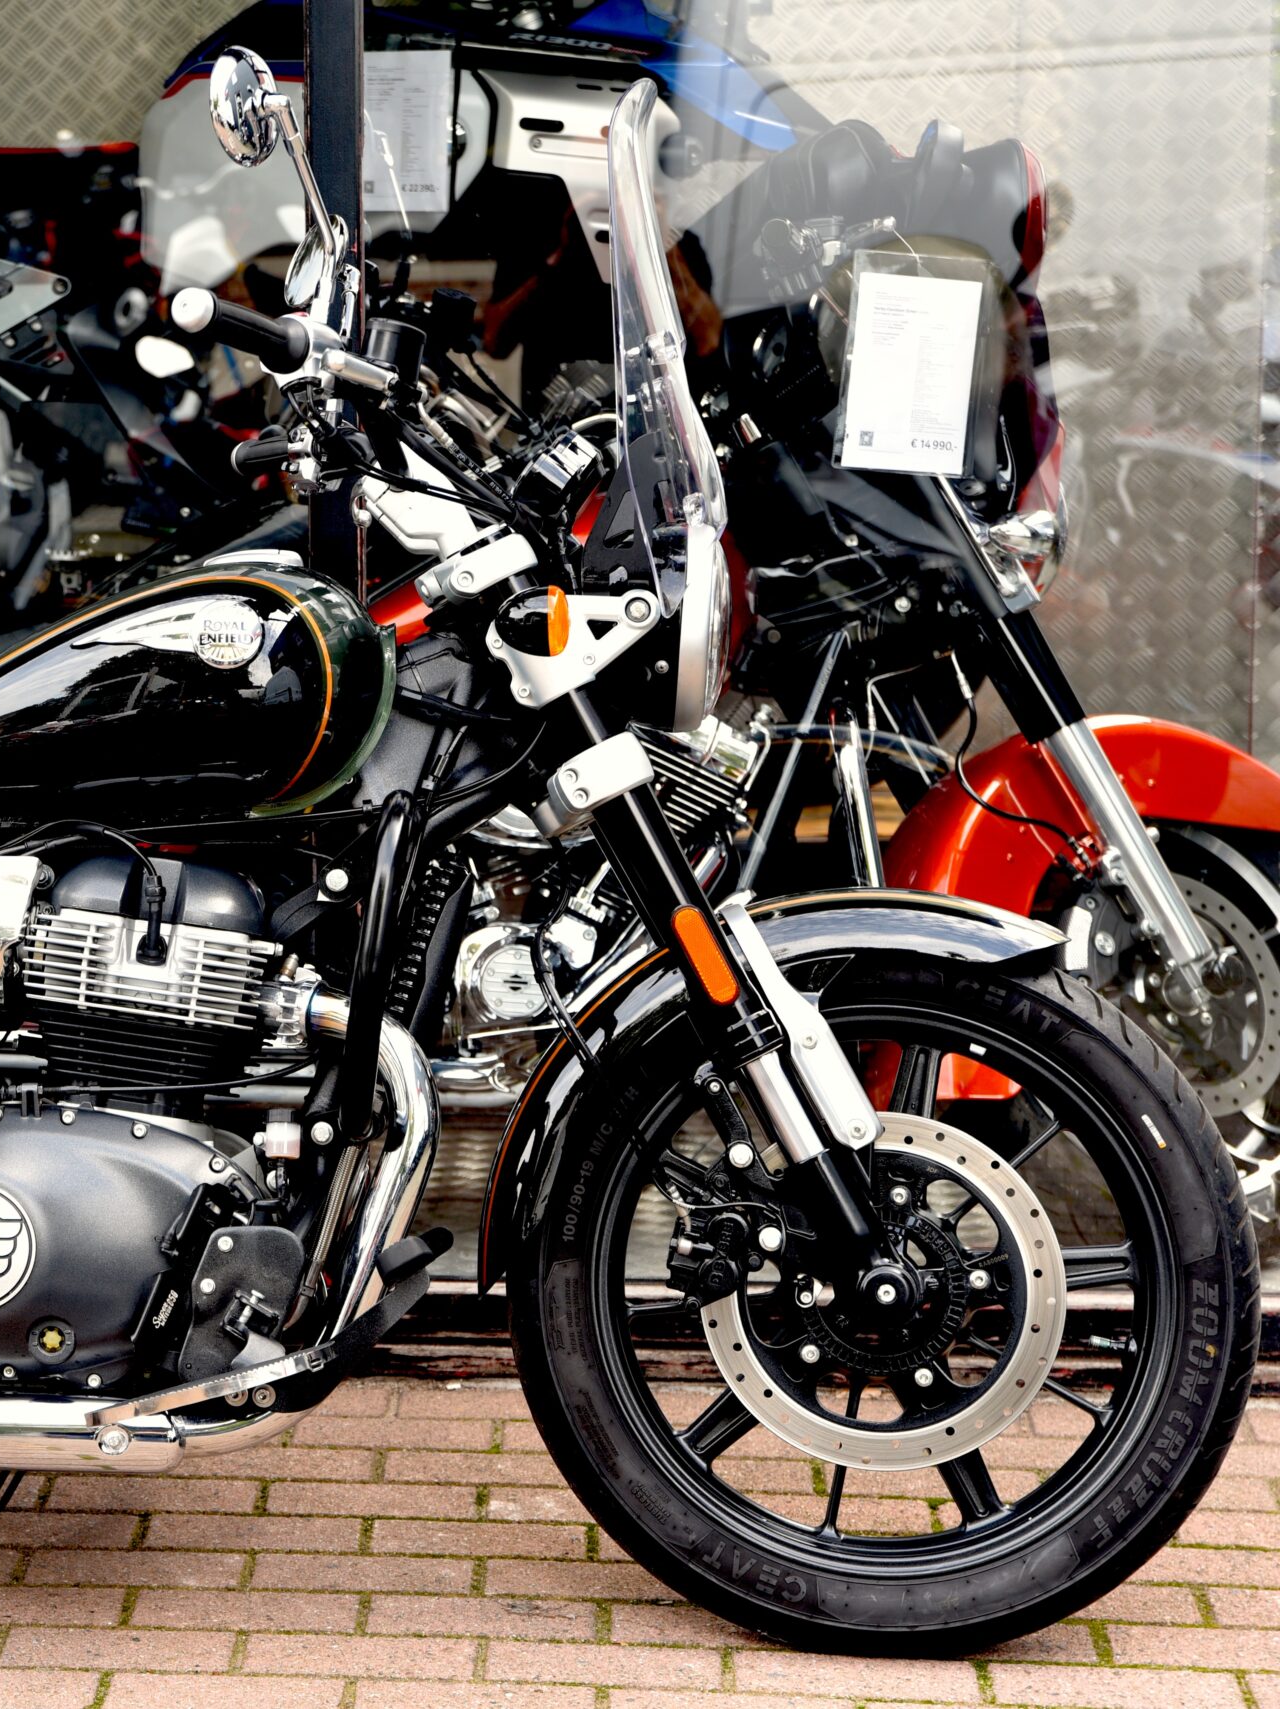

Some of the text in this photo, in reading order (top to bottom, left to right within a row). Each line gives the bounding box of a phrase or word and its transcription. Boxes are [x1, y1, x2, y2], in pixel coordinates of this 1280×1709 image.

[910, 438, 918, 448] €
[199, 633, 255, 646] ENFIELD
[203, 619, 246, 632] ROYAL
[562, 1159, 595, 1243] 100/90-19
[1179, 1279, 1221, 1406] ZOOM
[702, 1541, 808, 1603] CEAT
